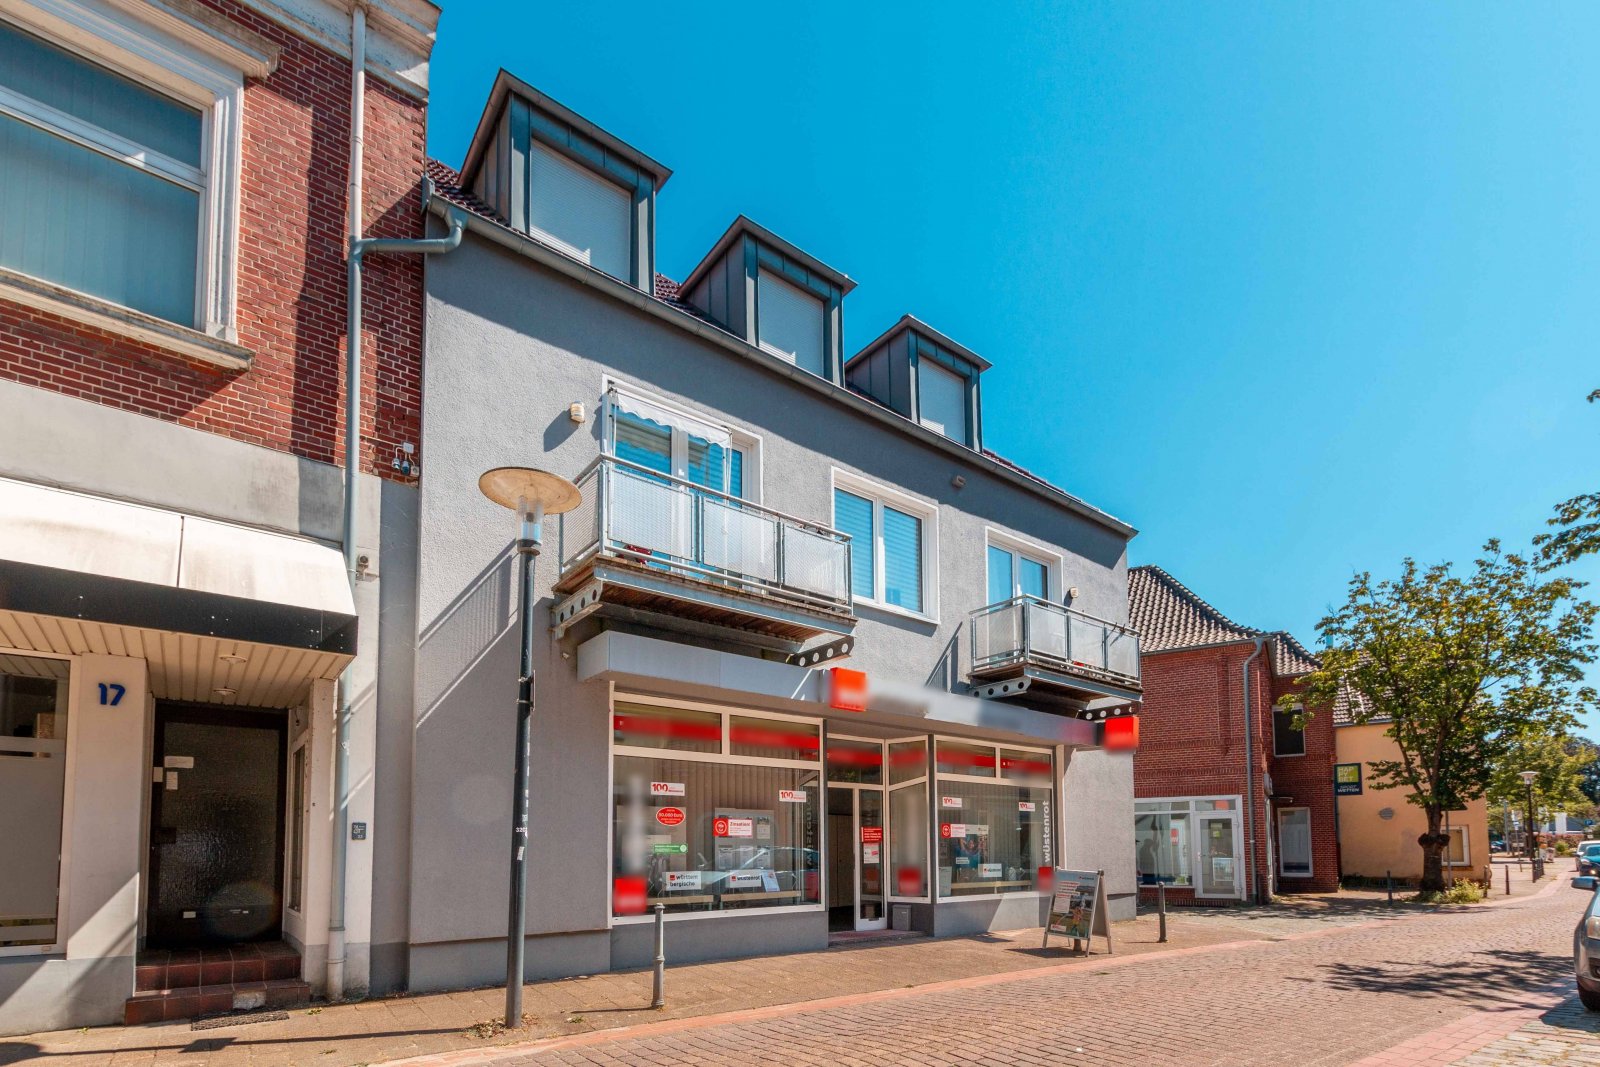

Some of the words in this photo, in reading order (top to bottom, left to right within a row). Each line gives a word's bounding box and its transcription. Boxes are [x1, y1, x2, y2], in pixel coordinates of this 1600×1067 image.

[98, 683, 125, 706] 17
[652, 783, 669, 792] 100
[1042, 800, 1051, 863] wüstenrot
